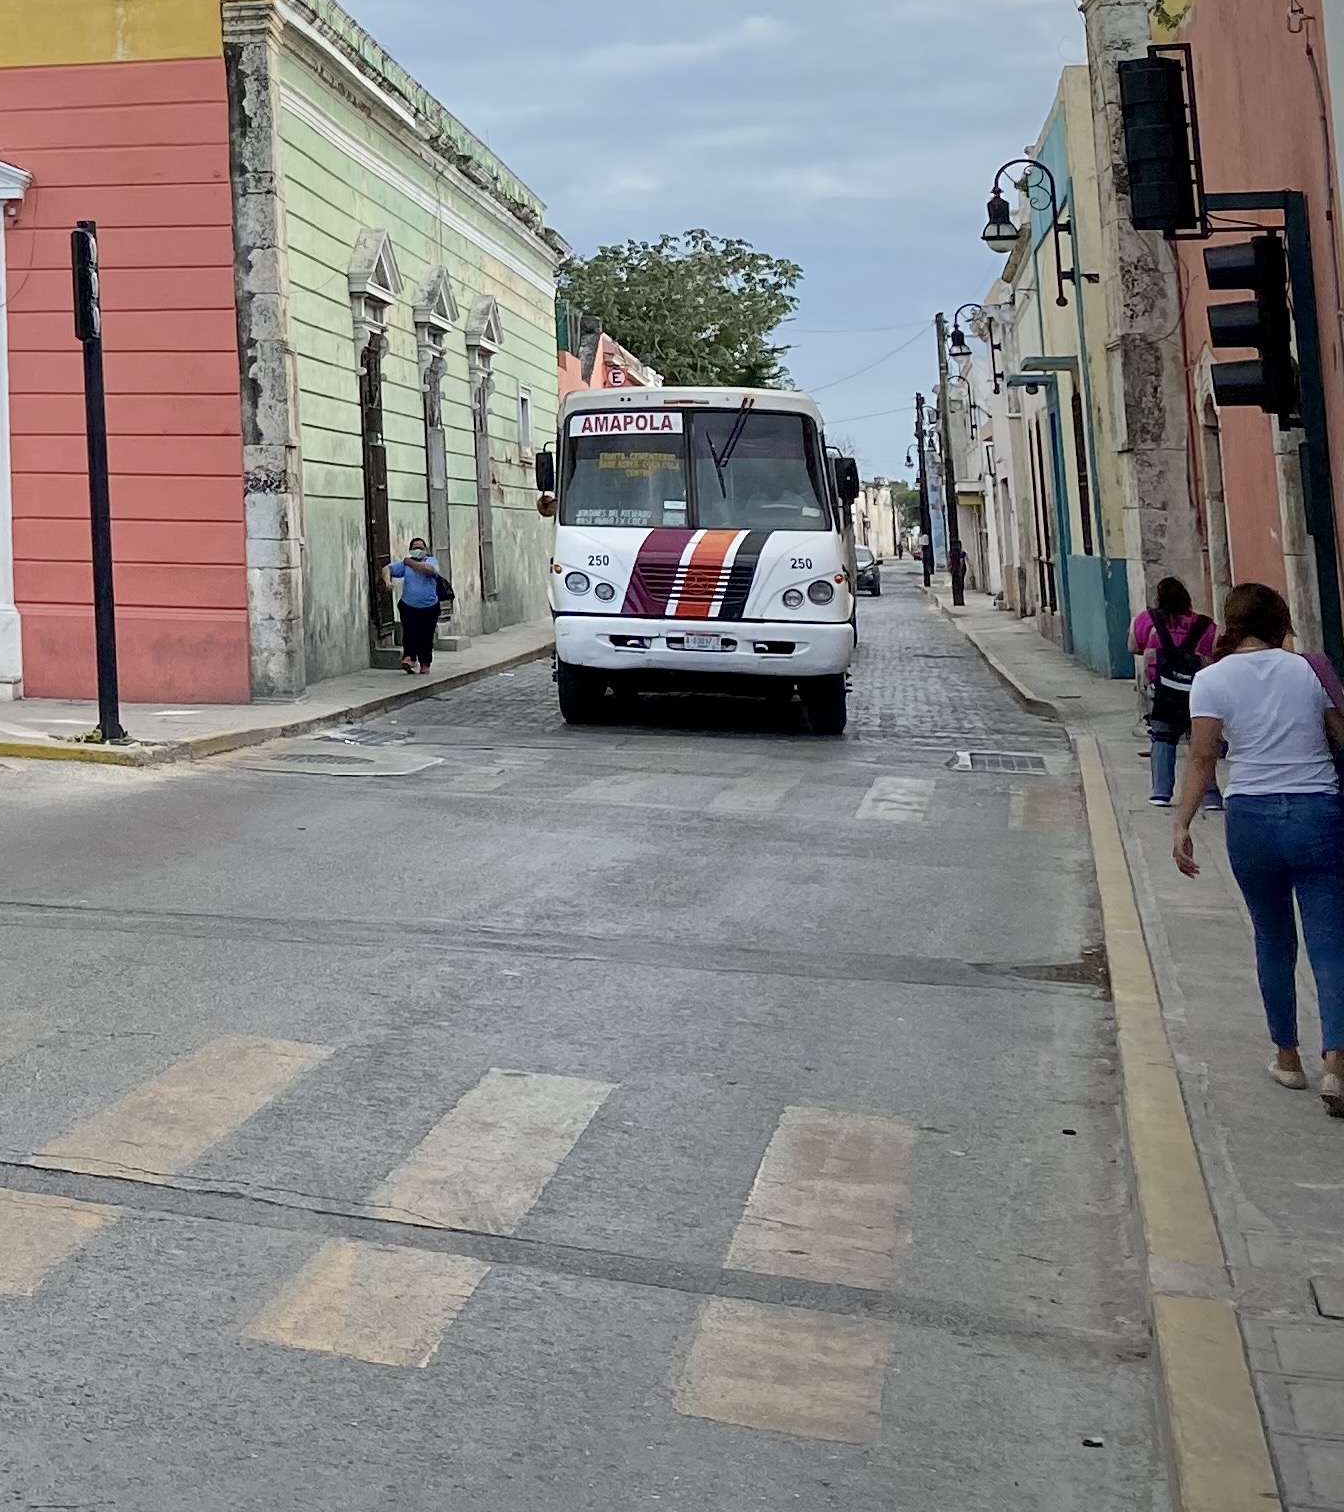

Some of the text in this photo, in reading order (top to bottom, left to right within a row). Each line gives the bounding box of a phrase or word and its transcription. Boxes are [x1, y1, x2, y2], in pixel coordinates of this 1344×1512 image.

[612, 372, 621, 383] E
[581, 415, 673, 433] AMAPOLA
[588, 555, 610, 567] 250
[790, 558, 813, 570] 250
